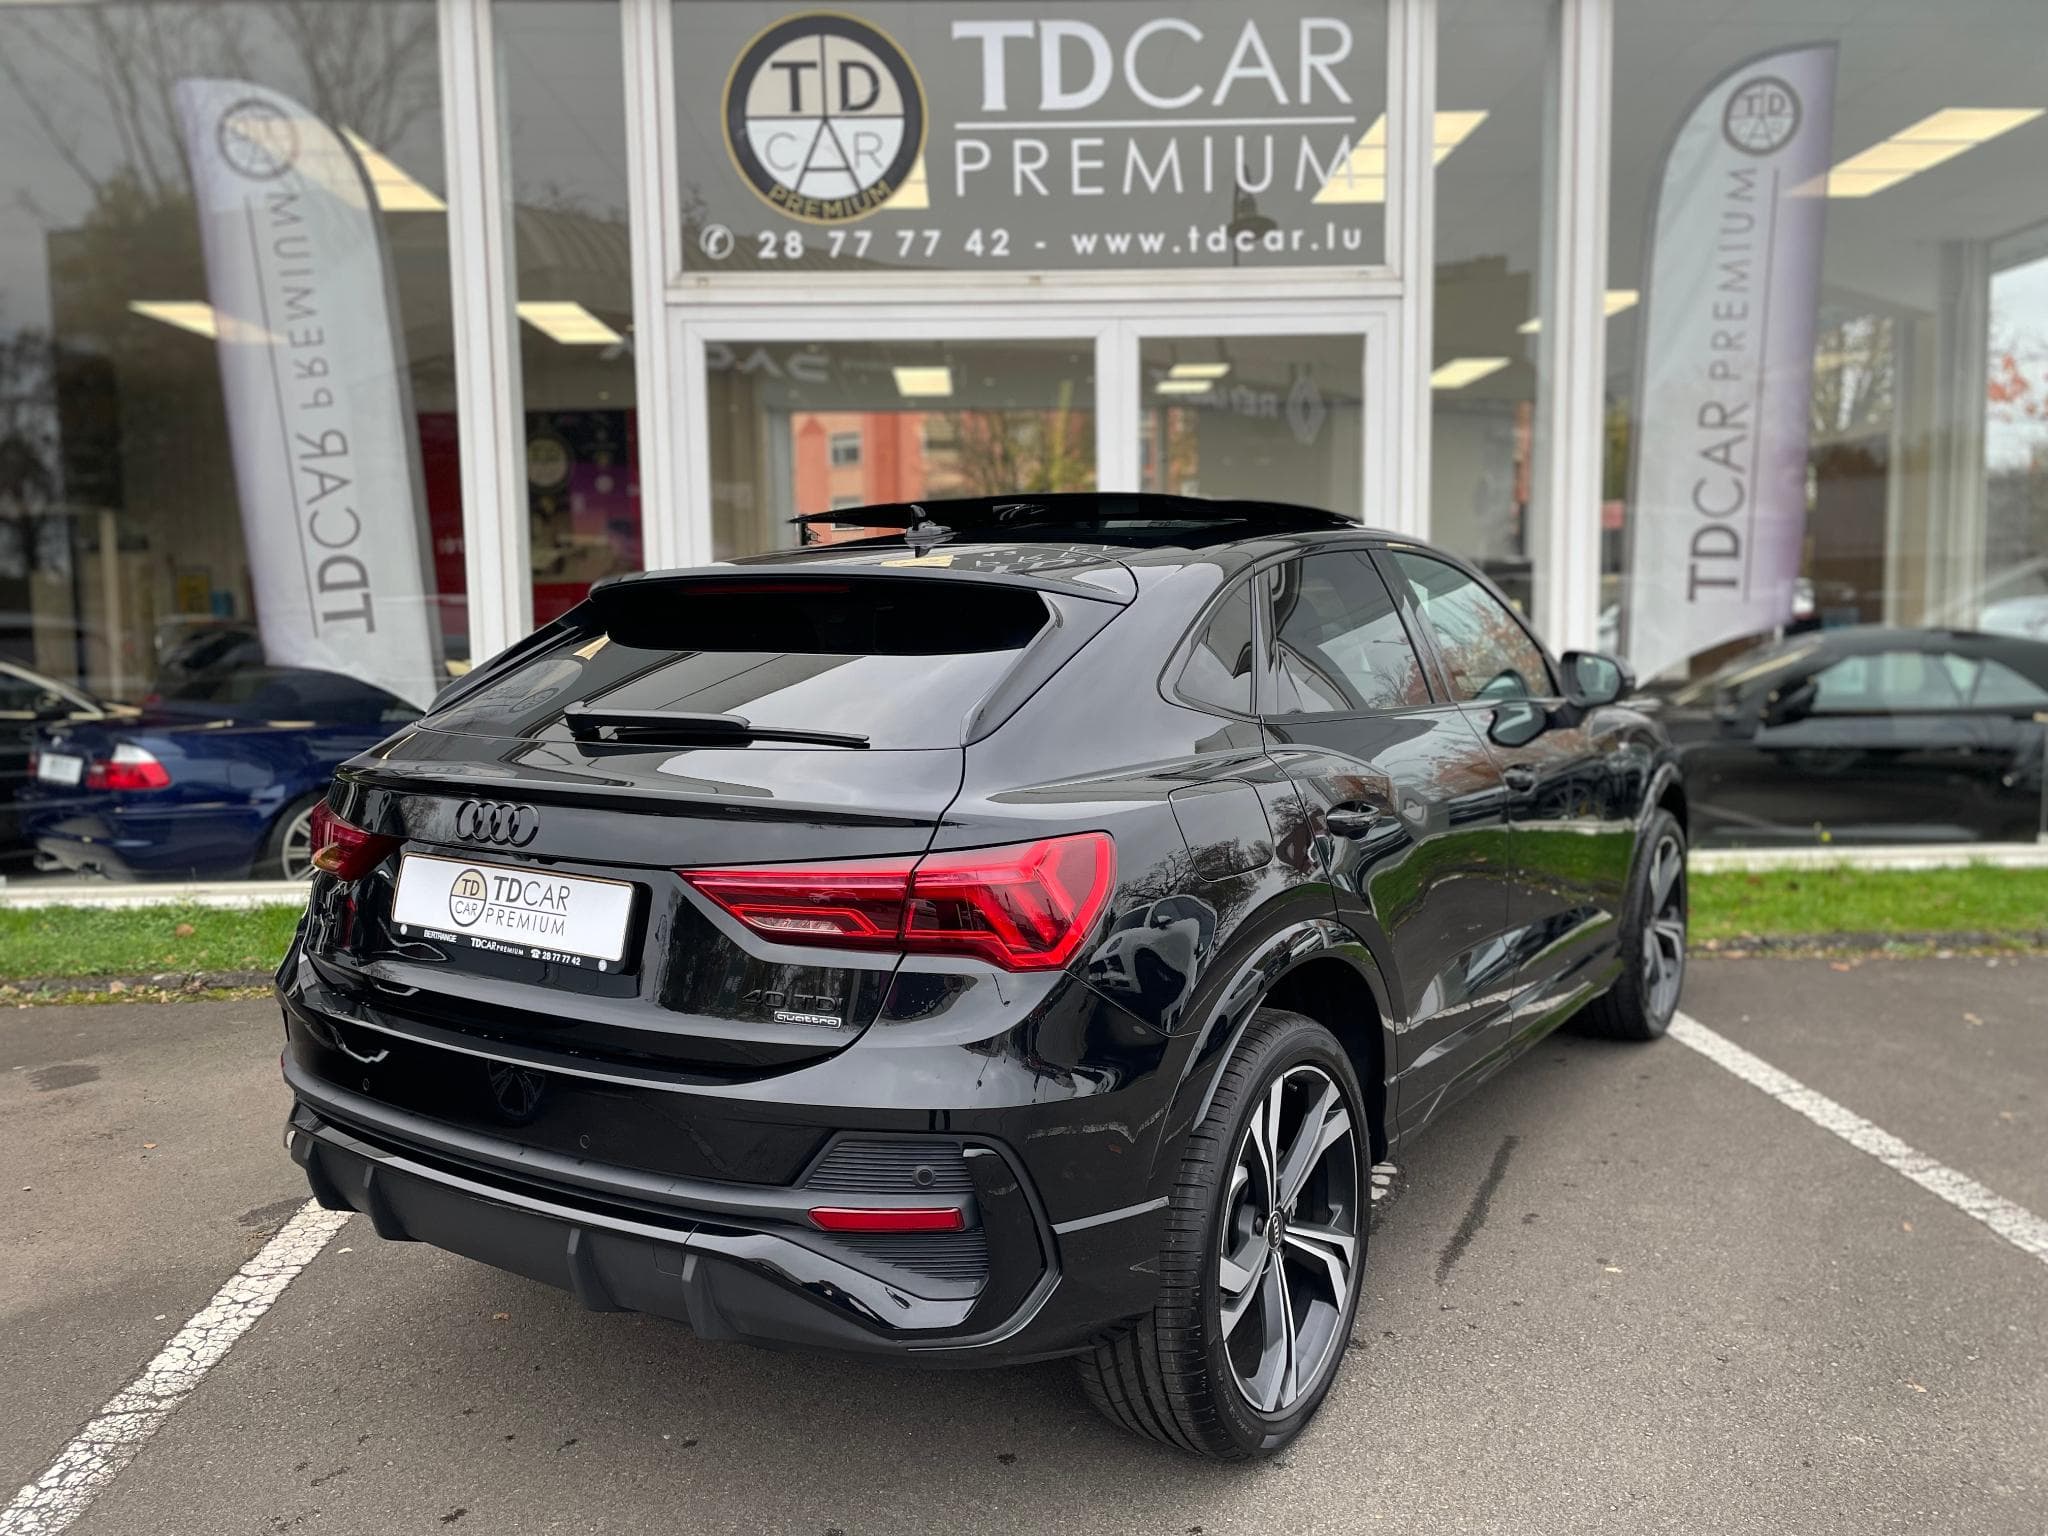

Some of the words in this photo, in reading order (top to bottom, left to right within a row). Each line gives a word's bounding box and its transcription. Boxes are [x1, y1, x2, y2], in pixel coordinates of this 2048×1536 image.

[952, 17, 1354, 111] TDCAR
[771, 61, 880, 112] TD
[764, 118, 885, 192] CAR
[955, 134, 1354, 197] PREMIUM
[767, 179, 894, 220] PREMIUM
[758, 230, 803, 259] 28
[827, 230, 872, 258] 77
[896, 230, 941, 258] 77
[965, 228, 1010, 257] 42
[1072, 222, 1361, 255] www.tdcar.lu
[1708, 167, 1758, 382] PREMIUM
[1687, 401, 1750, 604] TDCAR
[461, 878, 480, 897] TD
[493, 875, 571, 911] TDCAR
[455, 900, 478, 917] CAR
[485, 907, 566, 937] PREMIUM
[424, 929, 457, 943] BERTRANGE
[542, 951, 551, 961] 28
[552, 953, 561, 962] 77
[562, 954, 571, 964] 77
[571, 956, 581, 966] 42
[741, 989, 786, 1008] 40
[793, 993, 844, 1012] TDI
[776, 1013, 838, 1027] quattro
